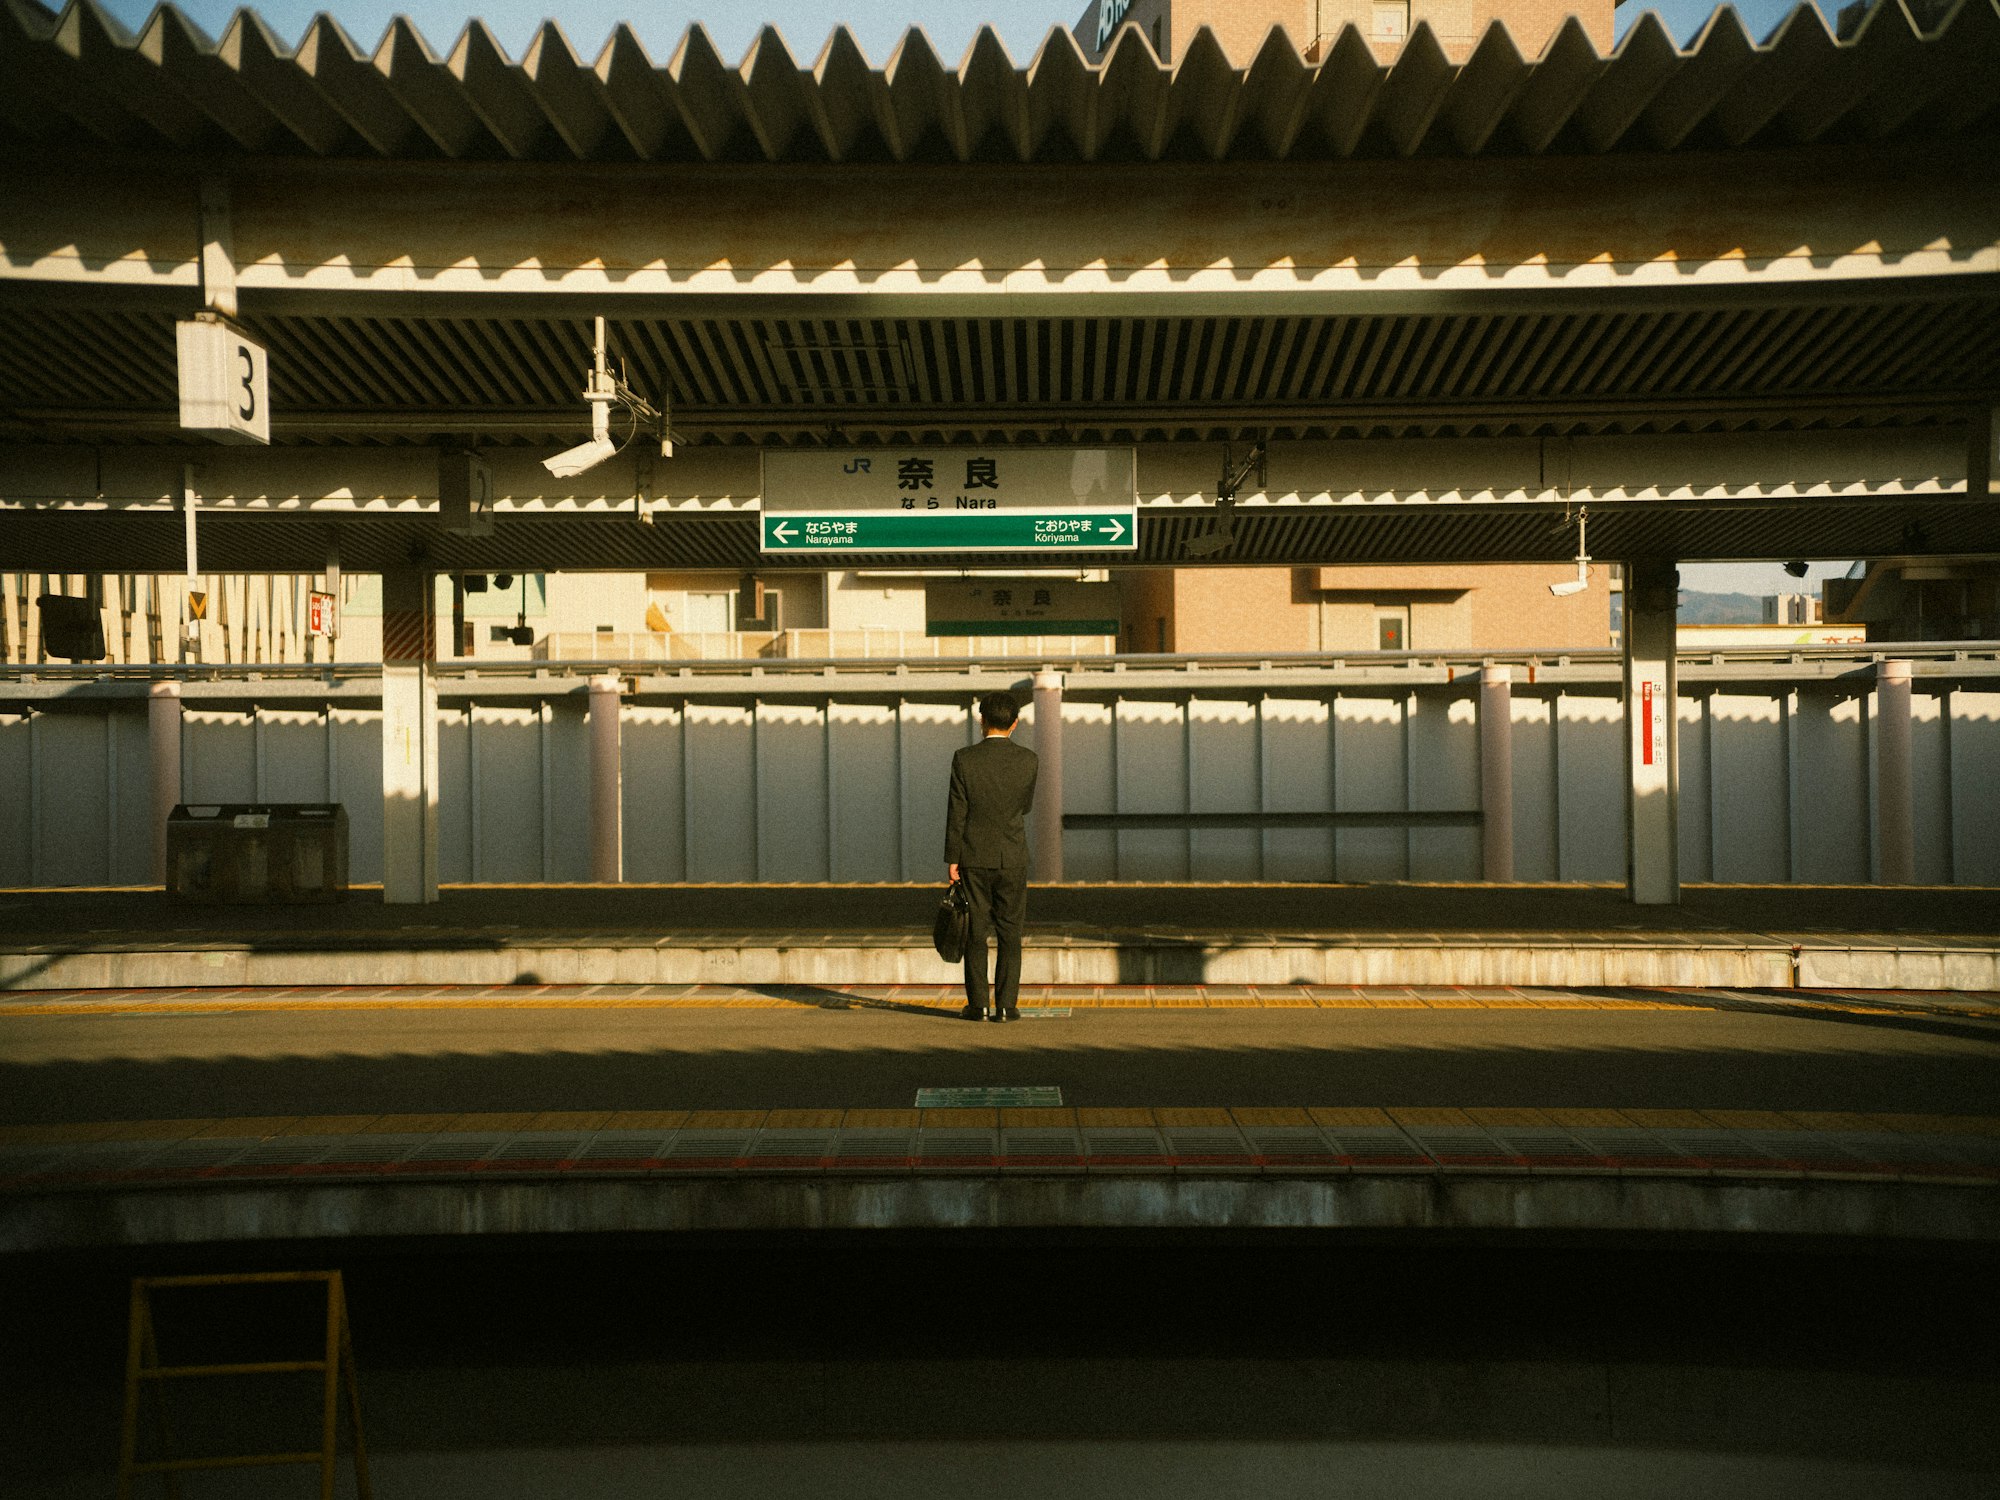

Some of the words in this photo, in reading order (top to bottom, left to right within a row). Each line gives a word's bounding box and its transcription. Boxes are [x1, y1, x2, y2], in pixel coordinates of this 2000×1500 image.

[238, 345, 255, 422] 3
[843, 458, 871, 474] JR
[898, 457, 999, 490] 奈良
[901, 497, 940, 510] なら
[956, 496, 997, 510] Nara
[805, 521, 858, 534] ならやま
[1034, 520, 1092, 532] こおりやま
[805, 535, 854, 546] Narayama
[1034, 533, 1079, 544] Kōriyama
